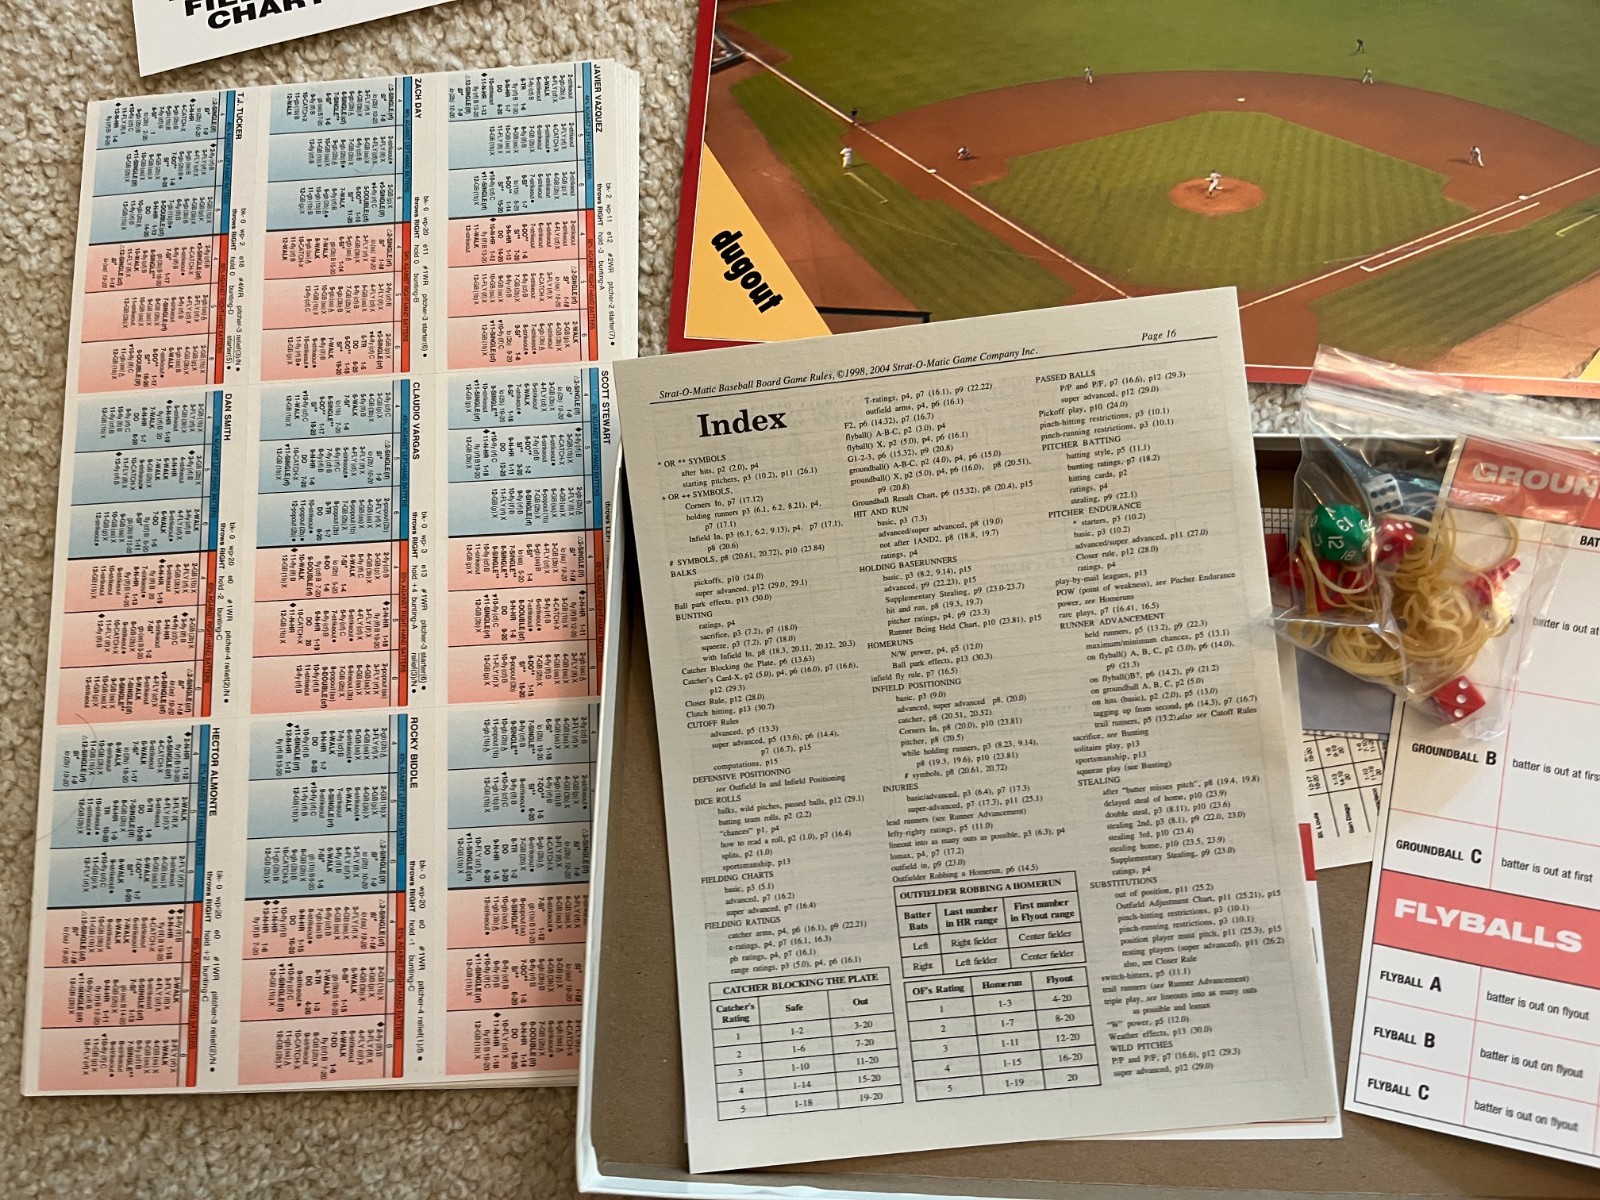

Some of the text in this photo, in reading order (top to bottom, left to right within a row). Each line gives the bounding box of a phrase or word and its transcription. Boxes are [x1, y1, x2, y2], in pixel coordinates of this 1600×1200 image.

[208, 0, 322, 29] CHAR
[414, 78, 422, 119] ZACH DAY
[593, 64, 603, 133] JAVIER VAZQUEZ
[235, 92, 244, 140] T.J. TUCKER
[597, 260, 605, 291] bunting-A
[711, 230, 784, 314] dugout
[606, 281, 614, 309] pitcher-2
[1141, 329, 1177, 341] Page 16
[659, 385, 717, 399] Strat-O-Matic
[718, 380, 754, 392] Baseball
[755, 377, 782, 388] Board
[783, 375, 807, 385] Game
[809, 371, 835, 382] Rules,
[869, 364, 890, 375] 2004
[892, 357, 950, 372] Strat-O-Matic
[952, 355, 977, 364] Game
[979, 350, 1019, 361] Company
[1021, 347, 1038, 356] Inc.
[1035, 369, 1096, 384] PASSED BALLS
[601, 370, 611, 445] SCOTT STEWART
[223, 393, 232, 441] DAN SMITH
[412, 381, 420, 460] CLAUDIO VARGAS
[696, 408, 788, 438] Index
[1041, 435, 1121, 451] PITCHER BATTING
[853, 505, 909, 518] HIT AND RUN
[1048, 501, 1142, 518] PITCHER ENDURANCE
[1336, 516, 1354, 532] 13
[1327, 535, 1345, 549] 12
[859, 555, 958, 573] HOLDING BASERUNNERS
[670, 568, 697, 578] BALKS
[675, 610, 713, 621] BUNTING
[1059, 612, 1165, 630] RUNNER ADVANCEMENT
[1562, 622, 1570, 631] is
[1572, 624, 1588, 634] out
[1589, 626, 1600, 636] at
[867, 638, 914, 649] HOMERUNS
[871, 678, 962, 693] INFIELD POSITIONING
[686, 718, 739, 729] CUTOFF Rules
[409, 717, 418, 789] ROCKY BIDDLE
[1411, 742, 1497, 765] GROUNDBALL B
[208, 727, 220, 816] HECTOR ALMONTE
[692, 767, 791, 784] DEFENSIVE POSITIONING
[1512, 758, 1541, 771] batter
[1543, 765, 1551, 774] is
[1553, 767, 1570, 777] out
[1571, 769, 1582, 779] at
[882, 782, 919, 793] INJURIES
[1077, 775, 1121, 787] STEALING
[694, 794, 742, 806] DICE ROLLS
[1395, 839, 1482, 864] GROUNDBALL C
[408, 860, 416, 886] throws
[700, 870, 774, 884] FIELDING CHARTS
[1501, 857, 1593, 883] batter is out at first
[899, 887, 957, 899] OUTFIELDER
[959, 883, 1003, 894] ROBBING
[1013, 878, 1061, 890] HOMERUN
[1089, 876, 1158, 889] SUBSTITUTIONS
[408, 888, 416, 912] RIGHT
[704, 916, 781, 930] FIELDING RATINGS
[1394, 898, 1582, 953] FLYBALLS
[406, 954, 415, 991] bunting-C
[1046, 975, 1074, 985] Flyout
[722, 973, 879, 995] CATCHER BLOCKING THE PLATE
[982, 980, 1023, 989] Homerun
[1379, 970, 1442, 992] FLYBALL A
[912, 984, 965, 995] OF's Rating
[715, 1002, 755, 1013] Catcher's
[785, 1003, 804, 1012] Safe
[852, 998, 869, 1006] Out
[1486, 990, 1589, 1021] batter is out on flyout
[722, 1014, 750, 1024] Rating
[853, 1020, 873, 1030] 3-20
[855, 1038, 875, 1047] 7-20
[1001, 1038, 1019, 1047] 1-11
[1056, 1032, 1080, 1042] 12-20
[1373, 1026, 1435, 1048] FLYBALL B
[856, 1055, 879, 1065] 11-20
[1058, 1052, 1083, 1062] 16-20
[1479, 1047, 1584, 1078] batter is out on flyout
[791, 1062, 810, 1071] 1-10
[858, 1074, 882, 1083] 15-20
[1067, 1073, 1078, 1082] 20
[859, 1092, 883, 1102] 19-20
[1367, 1078, 1429, 1100] FLYBALL C
[1473, 1099, 1579, 1132] batter is out on flyout
